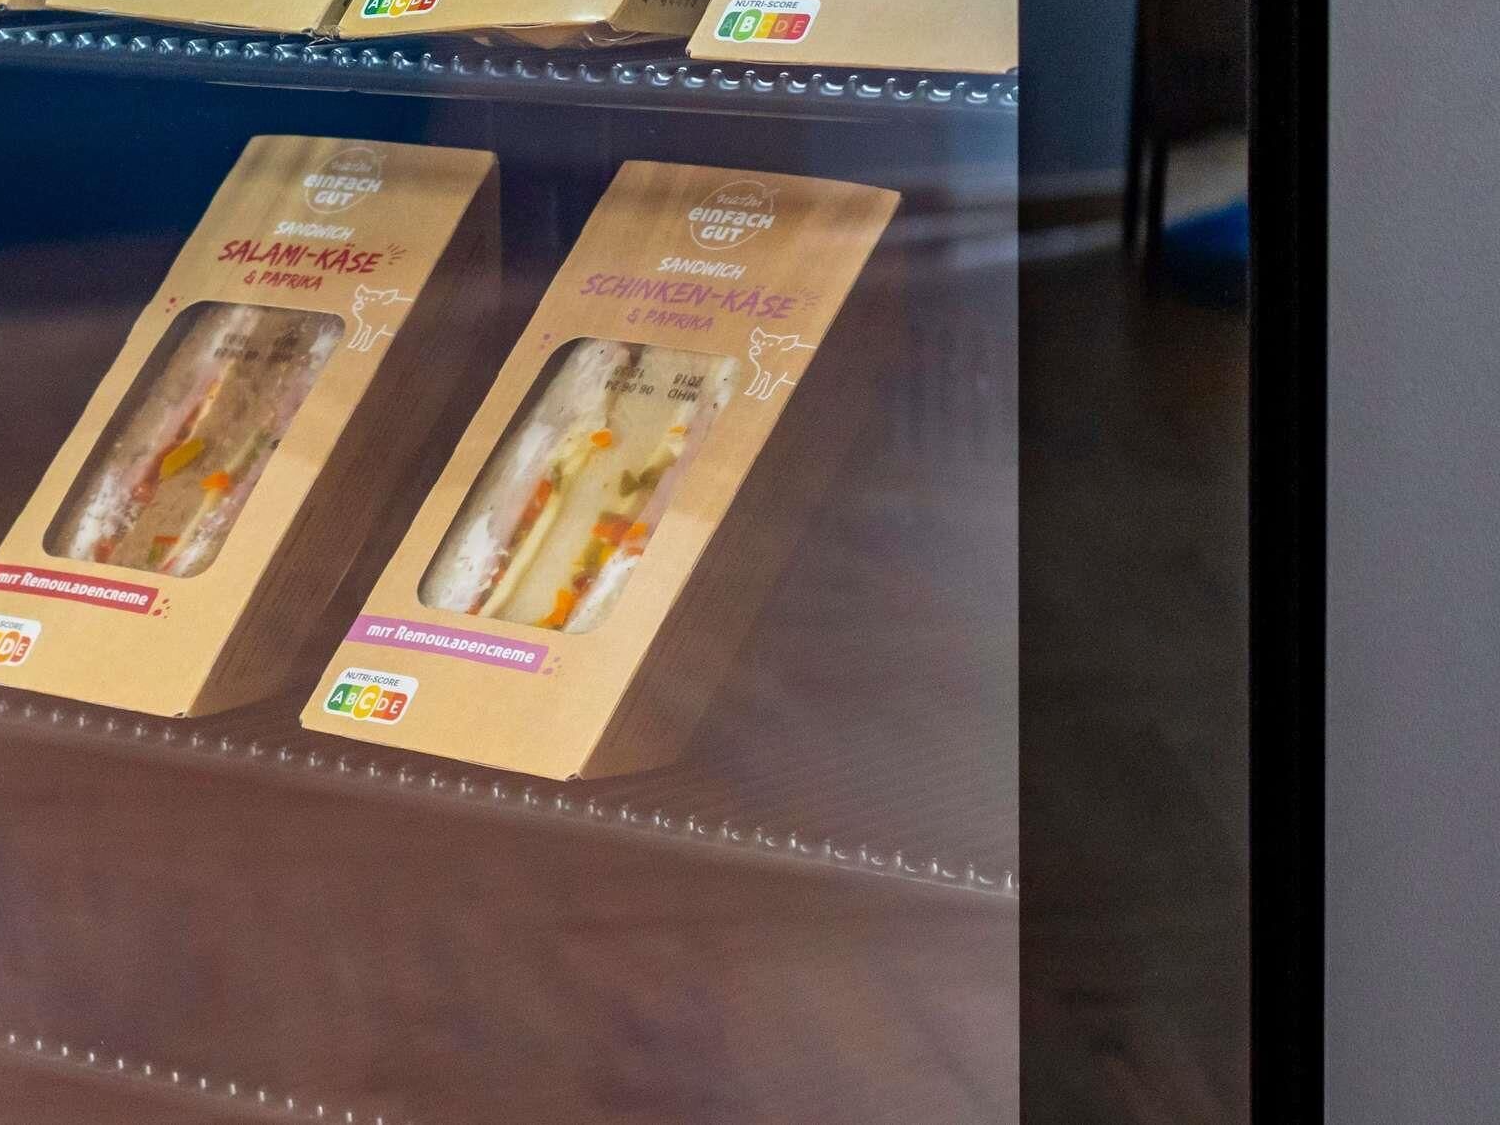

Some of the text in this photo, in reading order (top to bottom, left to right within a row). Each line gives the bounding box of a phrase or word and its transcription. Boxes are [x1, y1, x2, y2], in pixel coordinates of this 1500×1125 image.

[734, 0, 801, 9] NUTRI-SCORE
[314, 190, 355, 206] GUT
[274, 221, 356, 241] SANDWICH
[701, 224, 745, 242] GUT
[217, 240, 384, 274] SALAMI-KÄSE
[657, 257, 748, 280] SANDWICH
[259, 270, 324, 292] PAPRIKA
[580, 275, 798, 319] SCHINKEN-KÄSE
[643, 309, 715, 332] PAPRIKA
[346, 670, 401, 687] NUTRI-SCORE
